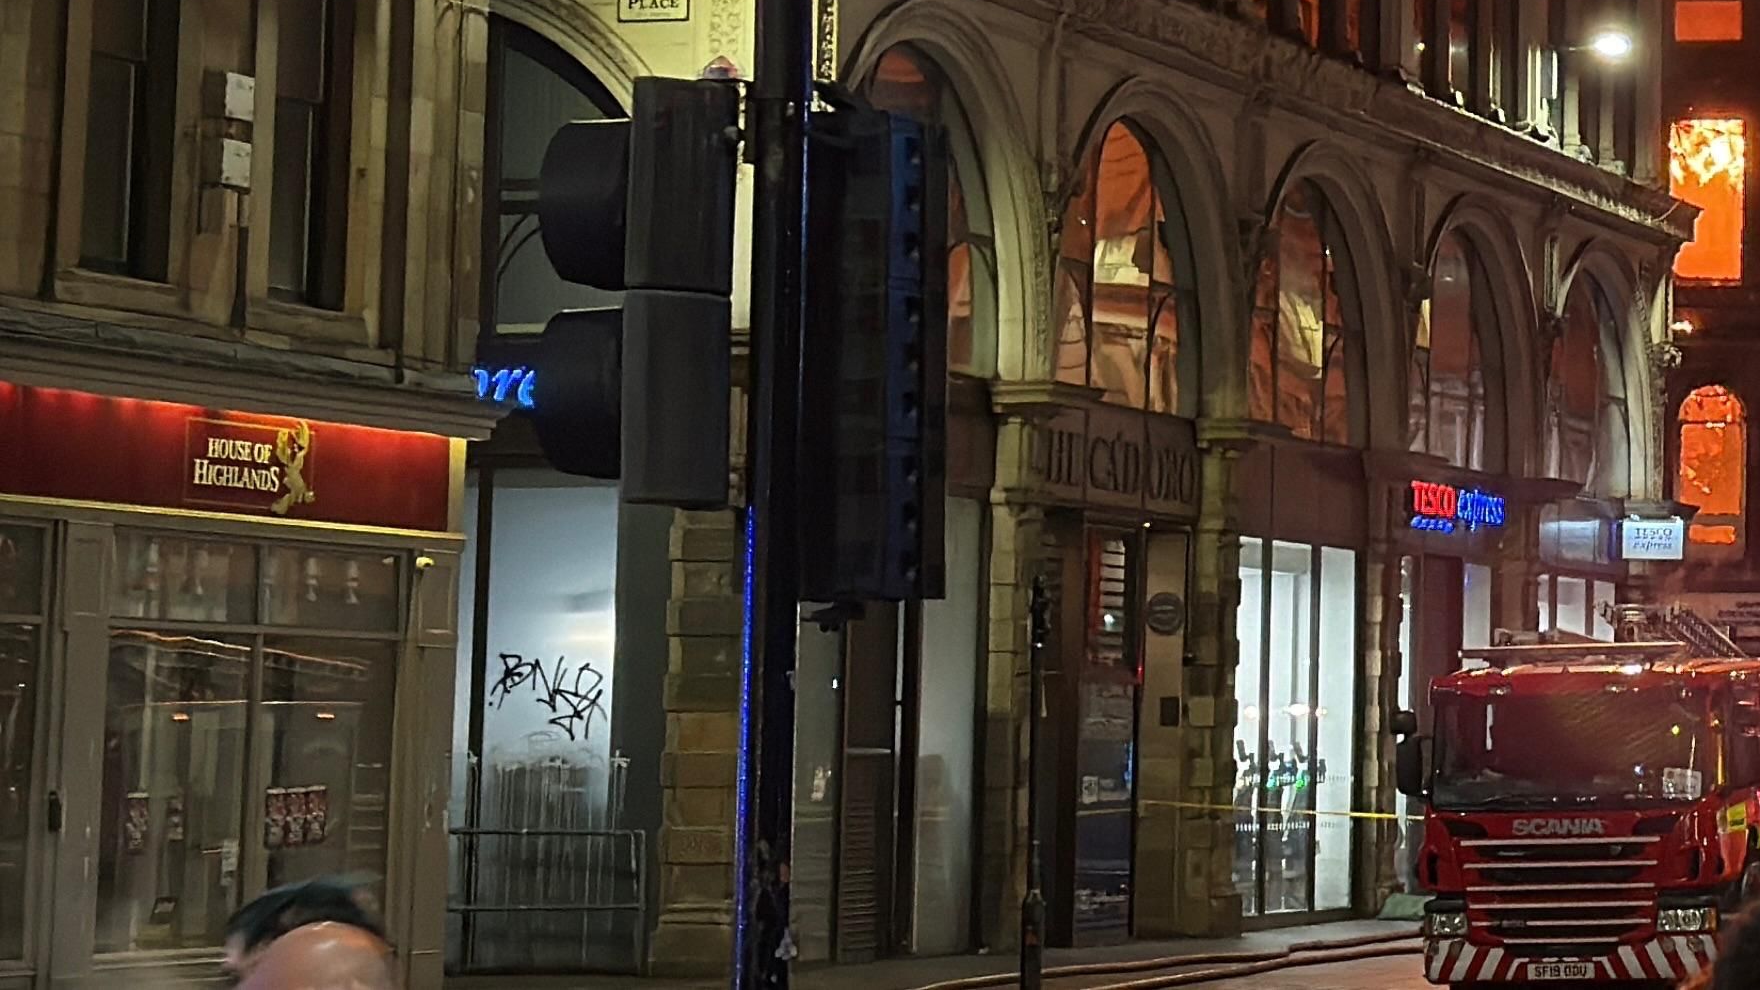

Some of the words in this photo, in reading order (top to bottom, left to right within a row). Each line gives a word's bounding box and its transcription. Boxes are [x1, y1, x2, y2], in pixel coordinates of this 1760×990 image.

[206, 437, 253, 462] HOUSE
[253, 443, 273, 464] OF
[193, 458, 280, 493] HIGHLANDS
[1410, 480, 1456, 519] TESCO
[1633, 527, 1673, 537] TESCO
[1511, 817, 1606, 836] SCANIA
